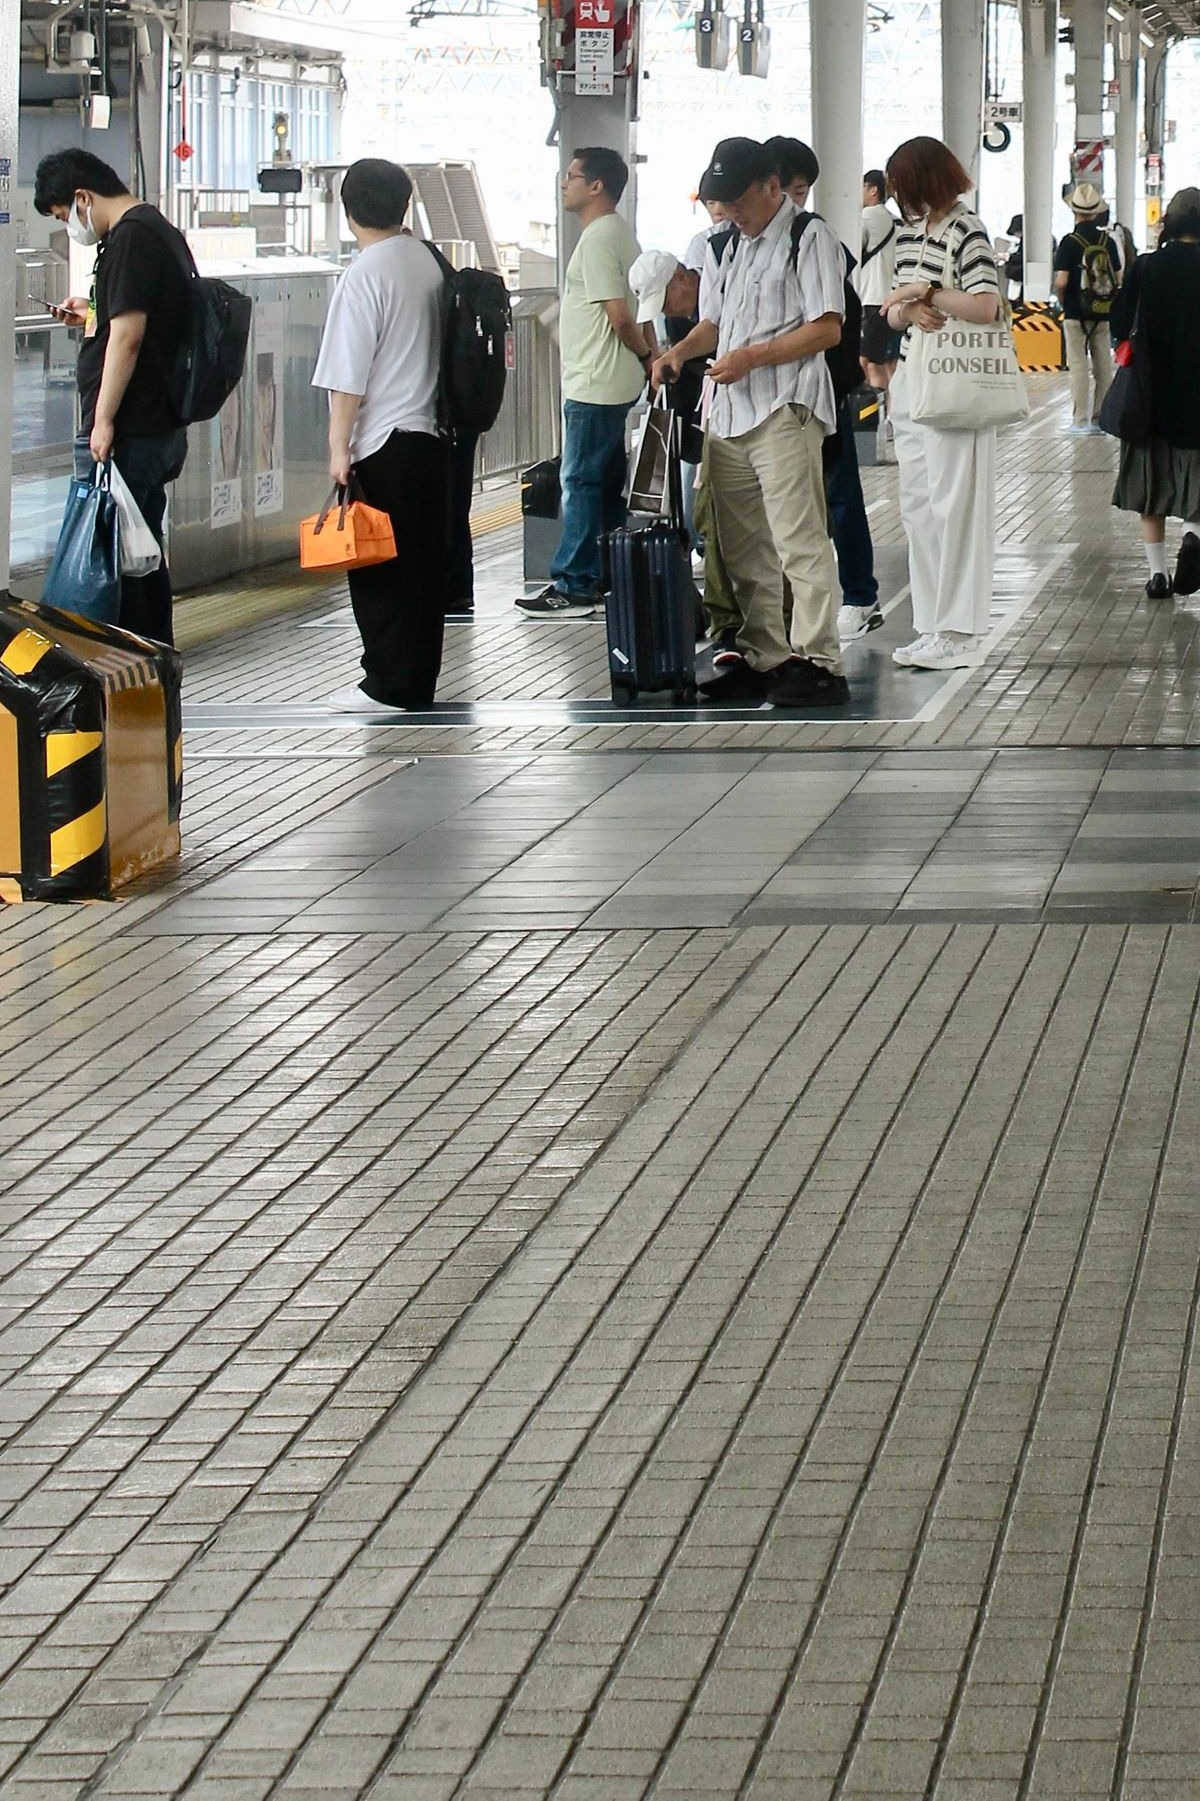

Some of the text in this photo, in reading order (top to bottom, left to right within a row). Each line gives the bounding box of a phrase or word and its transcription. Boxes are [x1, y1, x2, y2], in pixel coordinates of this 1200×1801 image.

[701, 20, 712, 32] 3
[742, 30, 752, 41] 2
[937, 331, 1010, 349] PORTE
[928, 357, 1016, 375] CONSEIL
